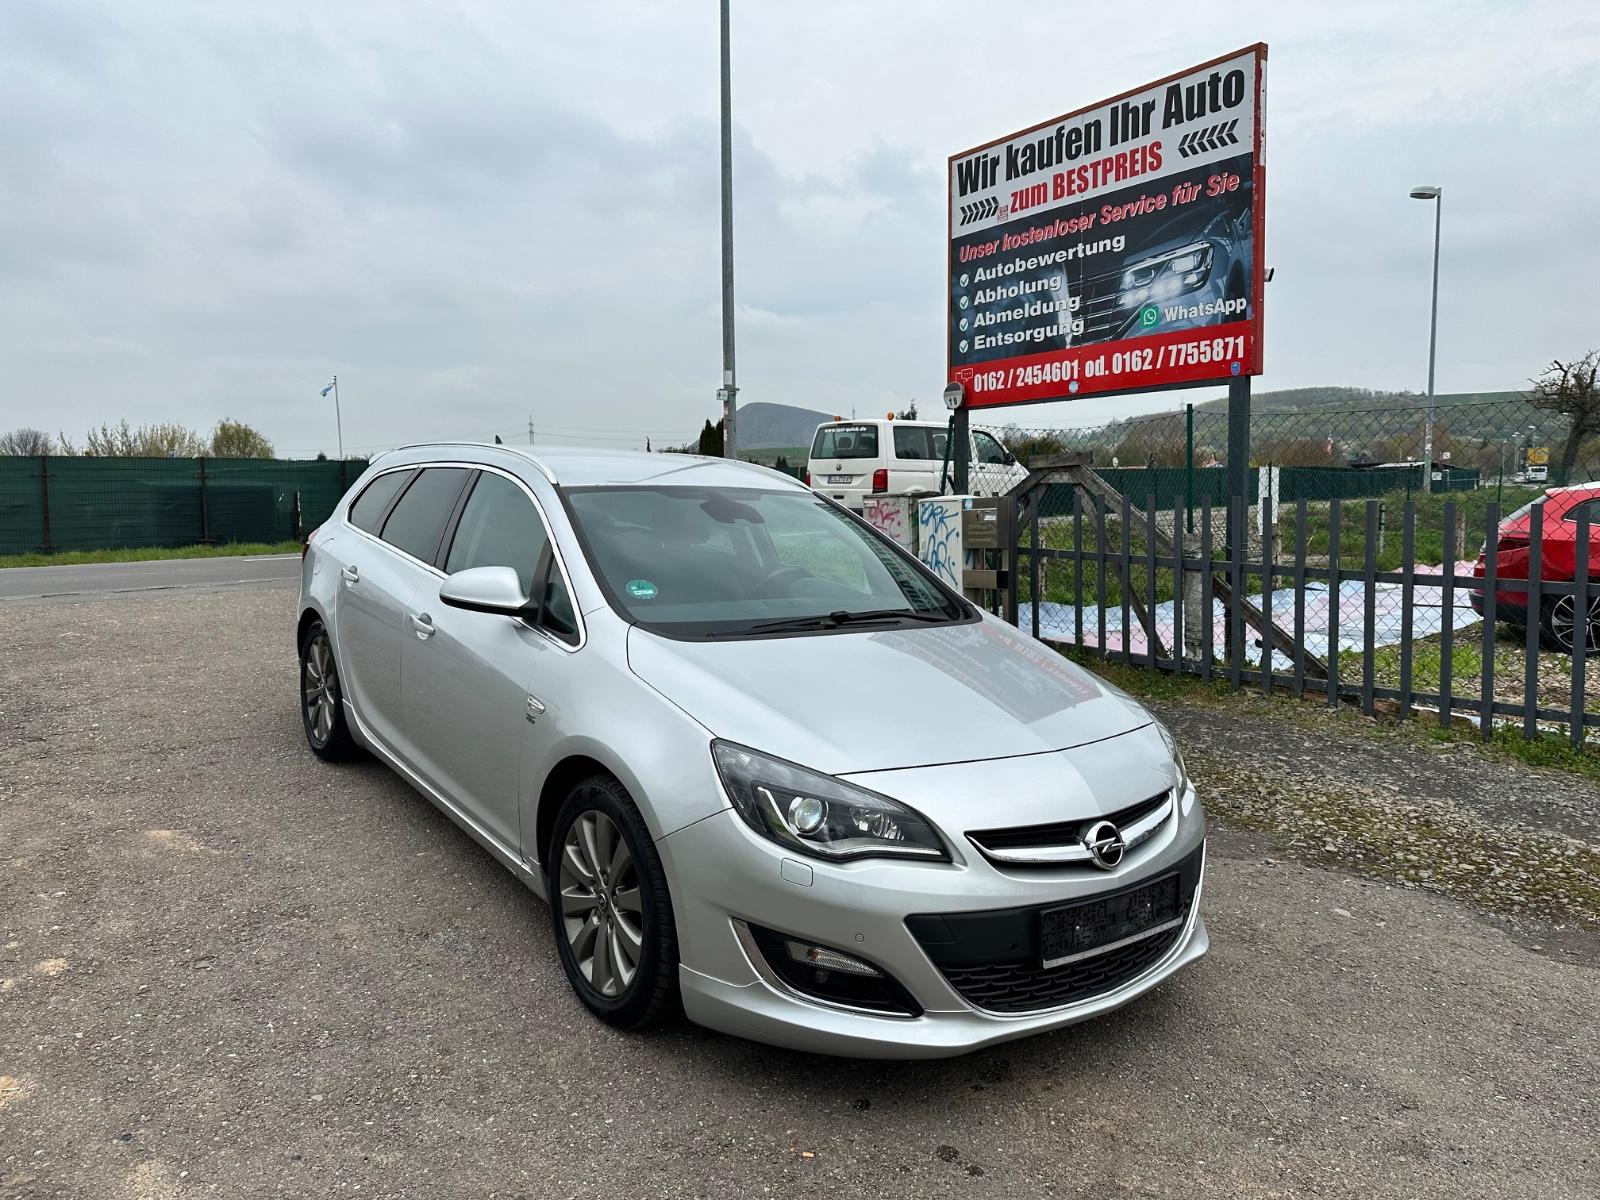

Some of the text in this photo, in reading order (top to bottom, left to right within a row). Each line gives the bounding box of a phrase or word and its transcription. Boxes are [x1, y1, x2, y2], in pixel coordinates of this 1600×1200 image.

[957, 69, 1245, 197] Wir kaufen Ihr Auto
[1010, 141, 1163, 214] zum BESTPREIS
[960, 240, 1000, 263] Unser
[1002, 212, 1096, 252] kostenloser
[1099, 193, 1167, 225] Service
[1171, 181, 1202, 206] für
[1206, 172, 1240, 197] Sie
[974, 234, 1126, 283] Autobewertung
[973, 275, 1062, 306] Abholung
[973, 295, 1081, 328] Abmeldung
[1164, 297, 1247, 322] WhatsApp
[974, 319, 1085, 350] Entsorgung
[974, 370, 1005, 393] 0162
[1007, 368, 1014, 389] /
[1016, 359, 1079, 388] 2454601
[1084, 355, 1109, 378] od.
[1112, 348, 1153, 375] 0162
[1156, 346, 1165, 369] /
[1168, 335, 1244, 367] 7755871
